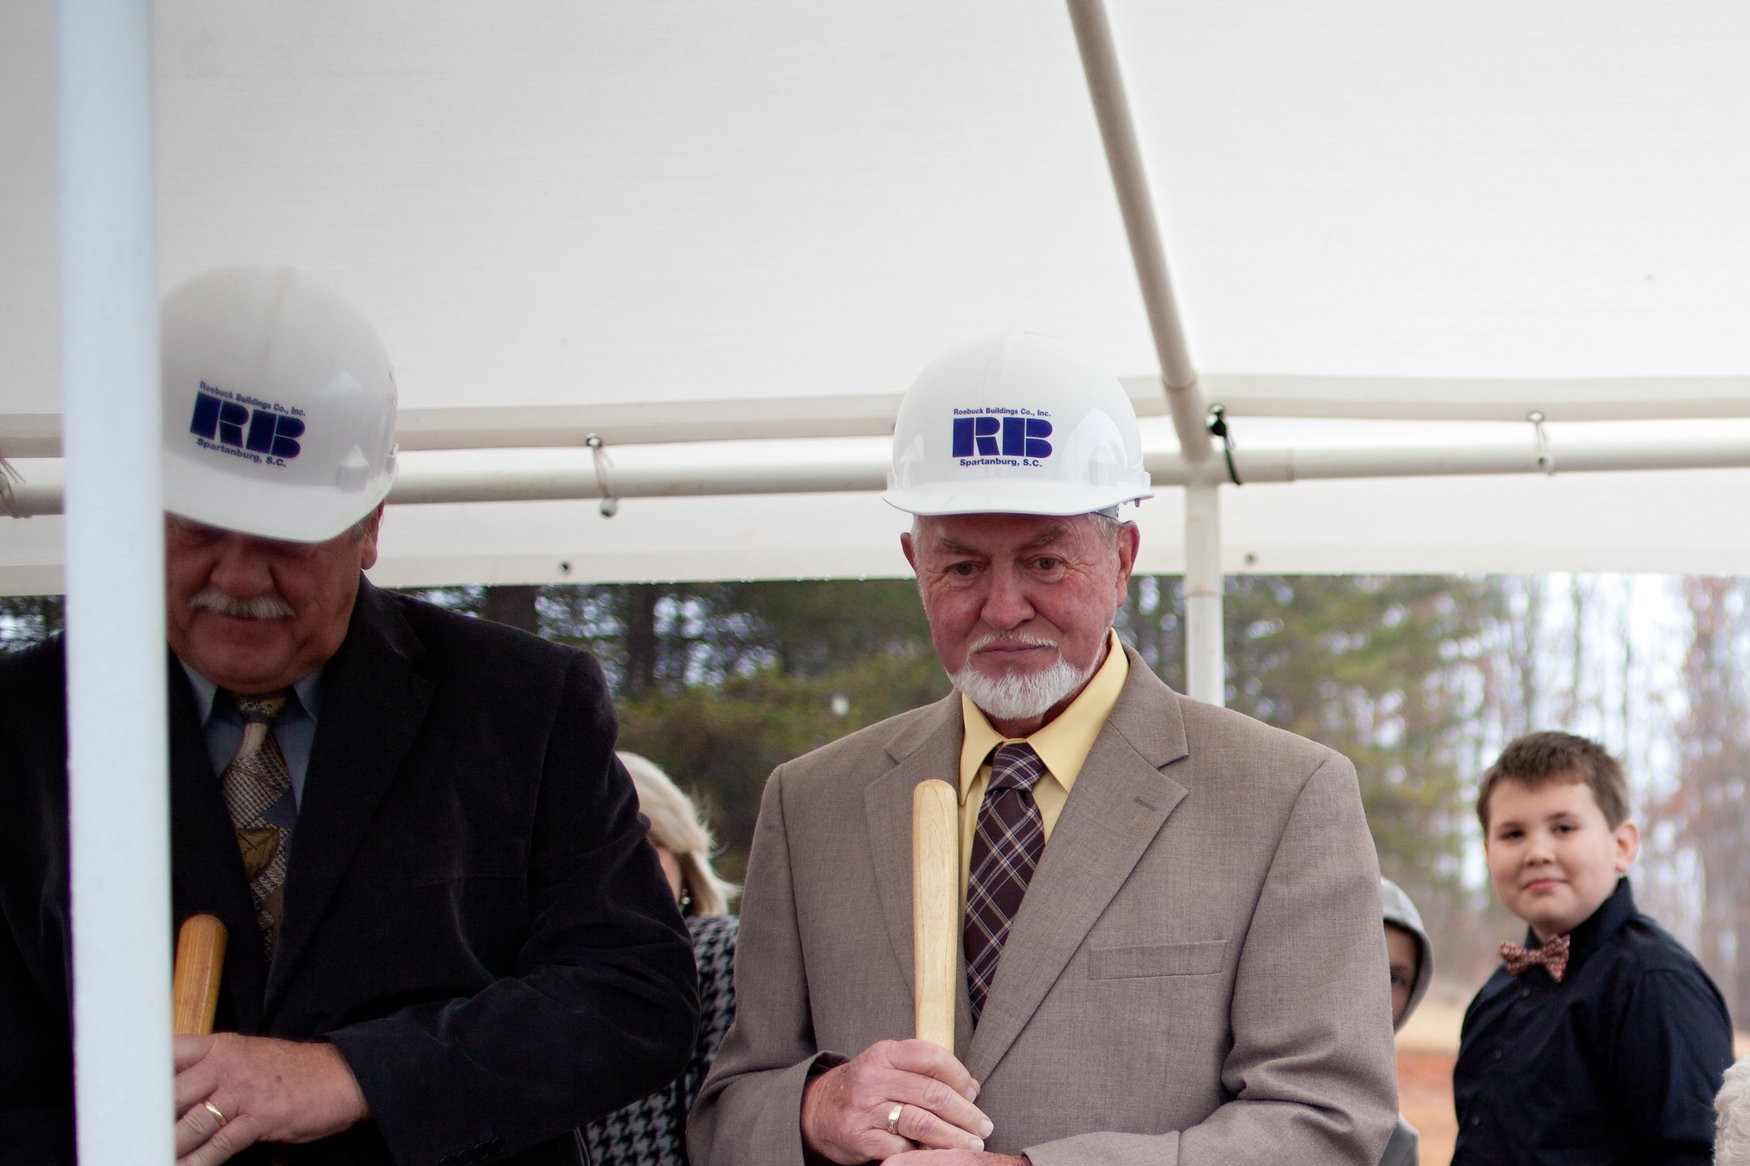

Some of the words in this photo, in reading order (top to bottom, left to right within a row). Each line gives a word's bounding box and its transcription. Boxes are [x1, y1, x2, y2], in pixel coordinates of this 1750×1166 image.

[200, 380, 233, 400] Roebuck
[236, 393, 271, 409] Buildings
[274, 403, 288, 414] Co.,
[292, 407, 306, 416] Inc.
[1021, 408, 1035, 416] Co.,
[190, 391, 305, 459] RB
[952, 417, 1052, 458] RB
[197, 438, 262, 463] Spartanburg,
[266, 457, 286, 467] S.C.
[960, 458, 1020, 467] Spartanburg,
[1023, 459, 1042, 467] S.C.
